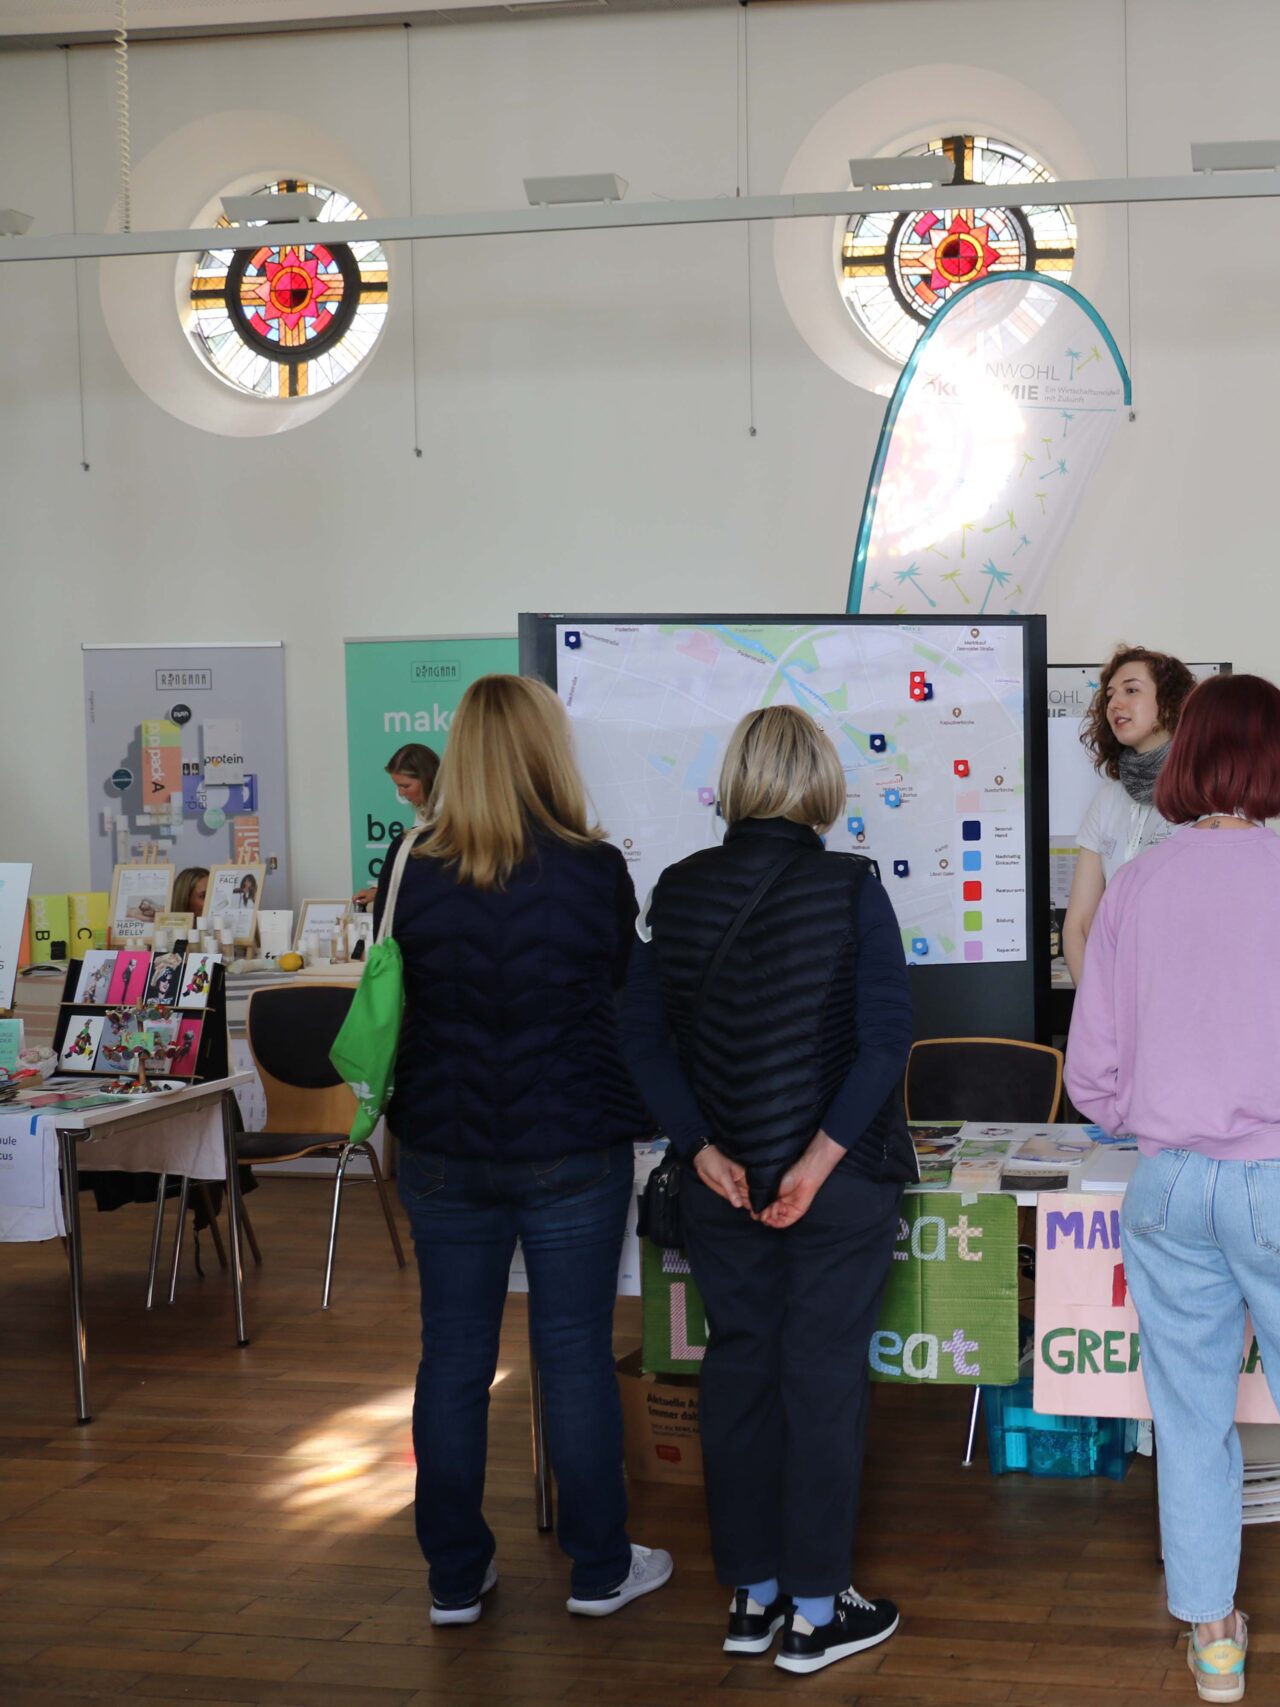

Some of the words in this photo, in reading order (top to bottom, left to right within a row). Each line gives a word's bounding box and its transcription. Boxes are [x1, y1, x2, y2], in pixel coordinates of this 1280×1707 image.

[384, 704, 452, 733] mak
[203, 754, 244, 767] protein
[35, 930, 50, 941] B
[77, 927, 92, 940] C
[868, 1328, 980, 1380] eat
